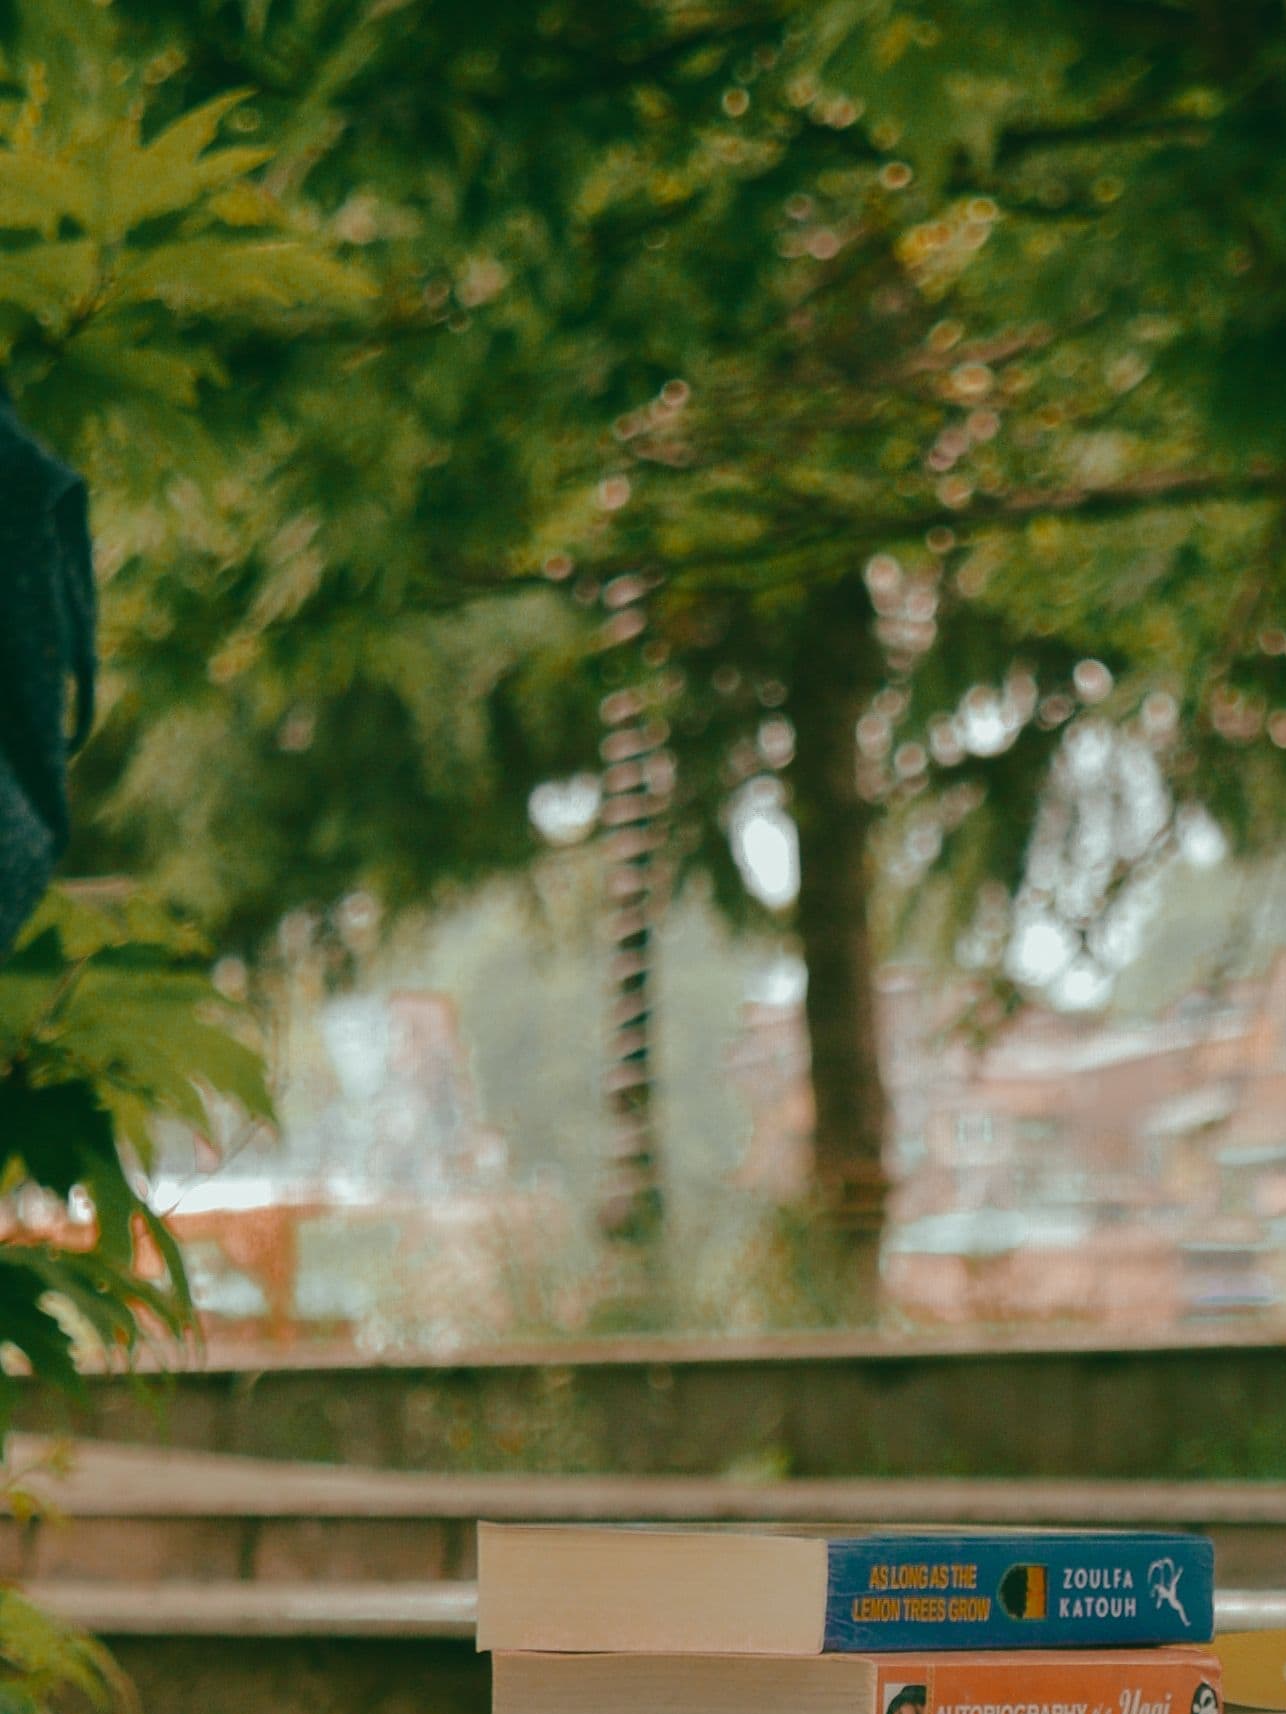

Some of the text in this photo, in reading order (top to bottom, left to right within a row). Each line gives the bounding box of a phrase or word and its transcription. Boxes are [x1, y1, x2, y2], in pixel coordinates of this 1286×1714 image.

[870, 1563, 977, 1590] AS LONG AS THE
[1063, 1567, 1133, 1590] ZOULFA
[853, 1596, 992, 1622] LEMON TREES GROW
[1060, 1596, 1137, 1619] KATOUH
